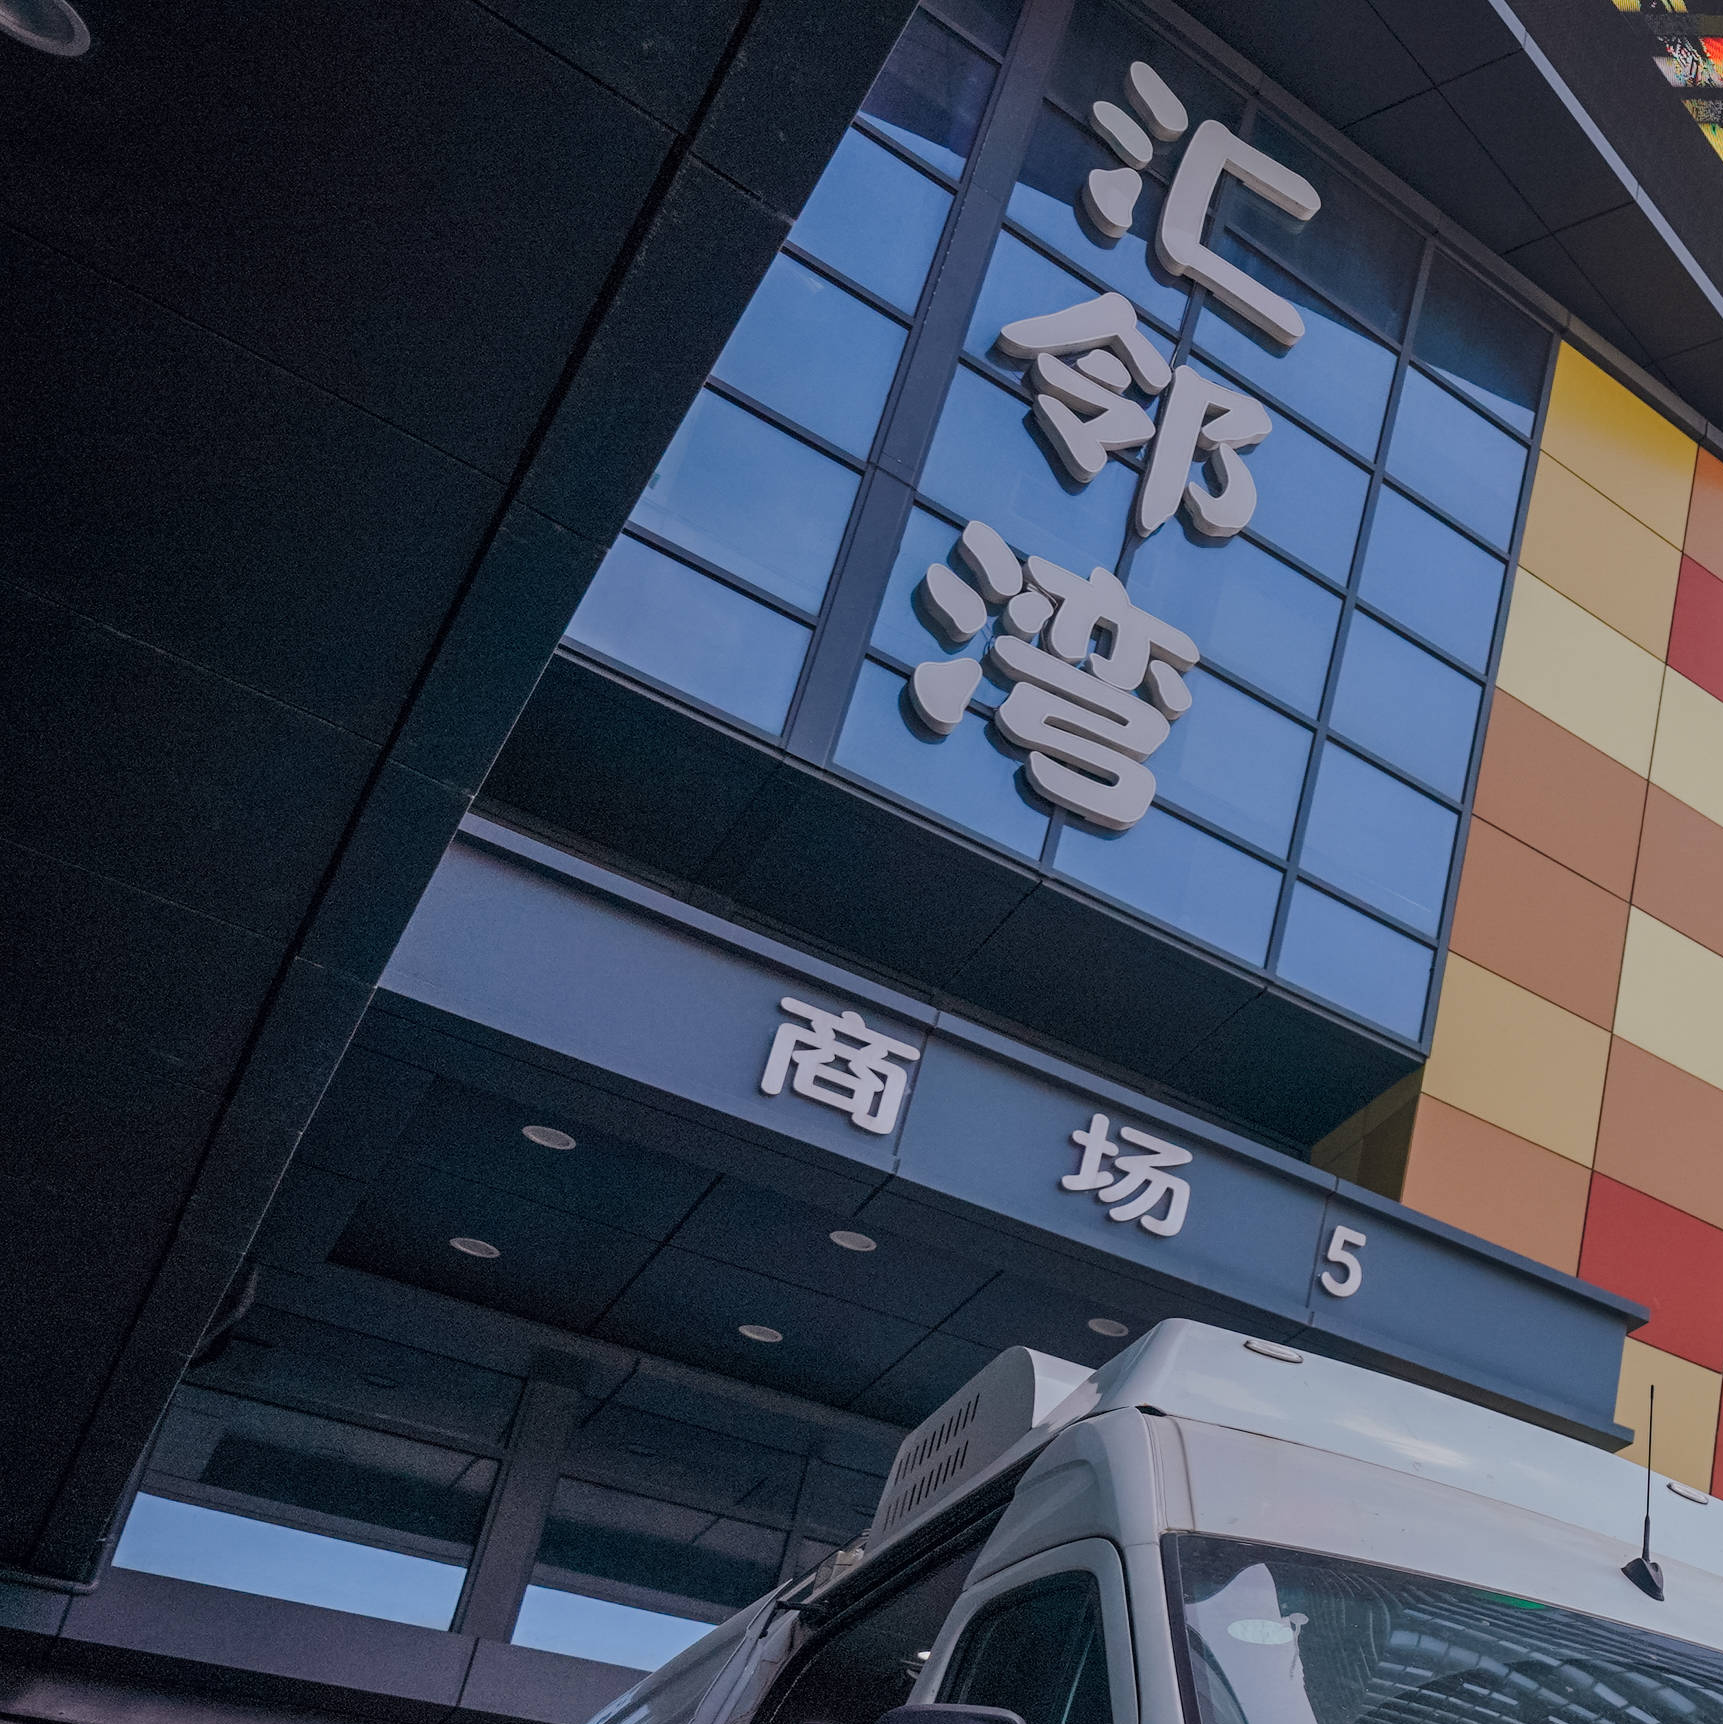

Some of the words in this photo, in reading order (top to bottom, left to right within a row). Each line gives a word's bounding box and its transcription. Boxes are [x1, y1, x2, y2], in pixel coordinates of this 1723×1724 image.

[909, 61, 1321, 831] 汇邻湾
[761, 996, 1193, 1237] 商场
[1320, 1225, 1367, 1298] 5
